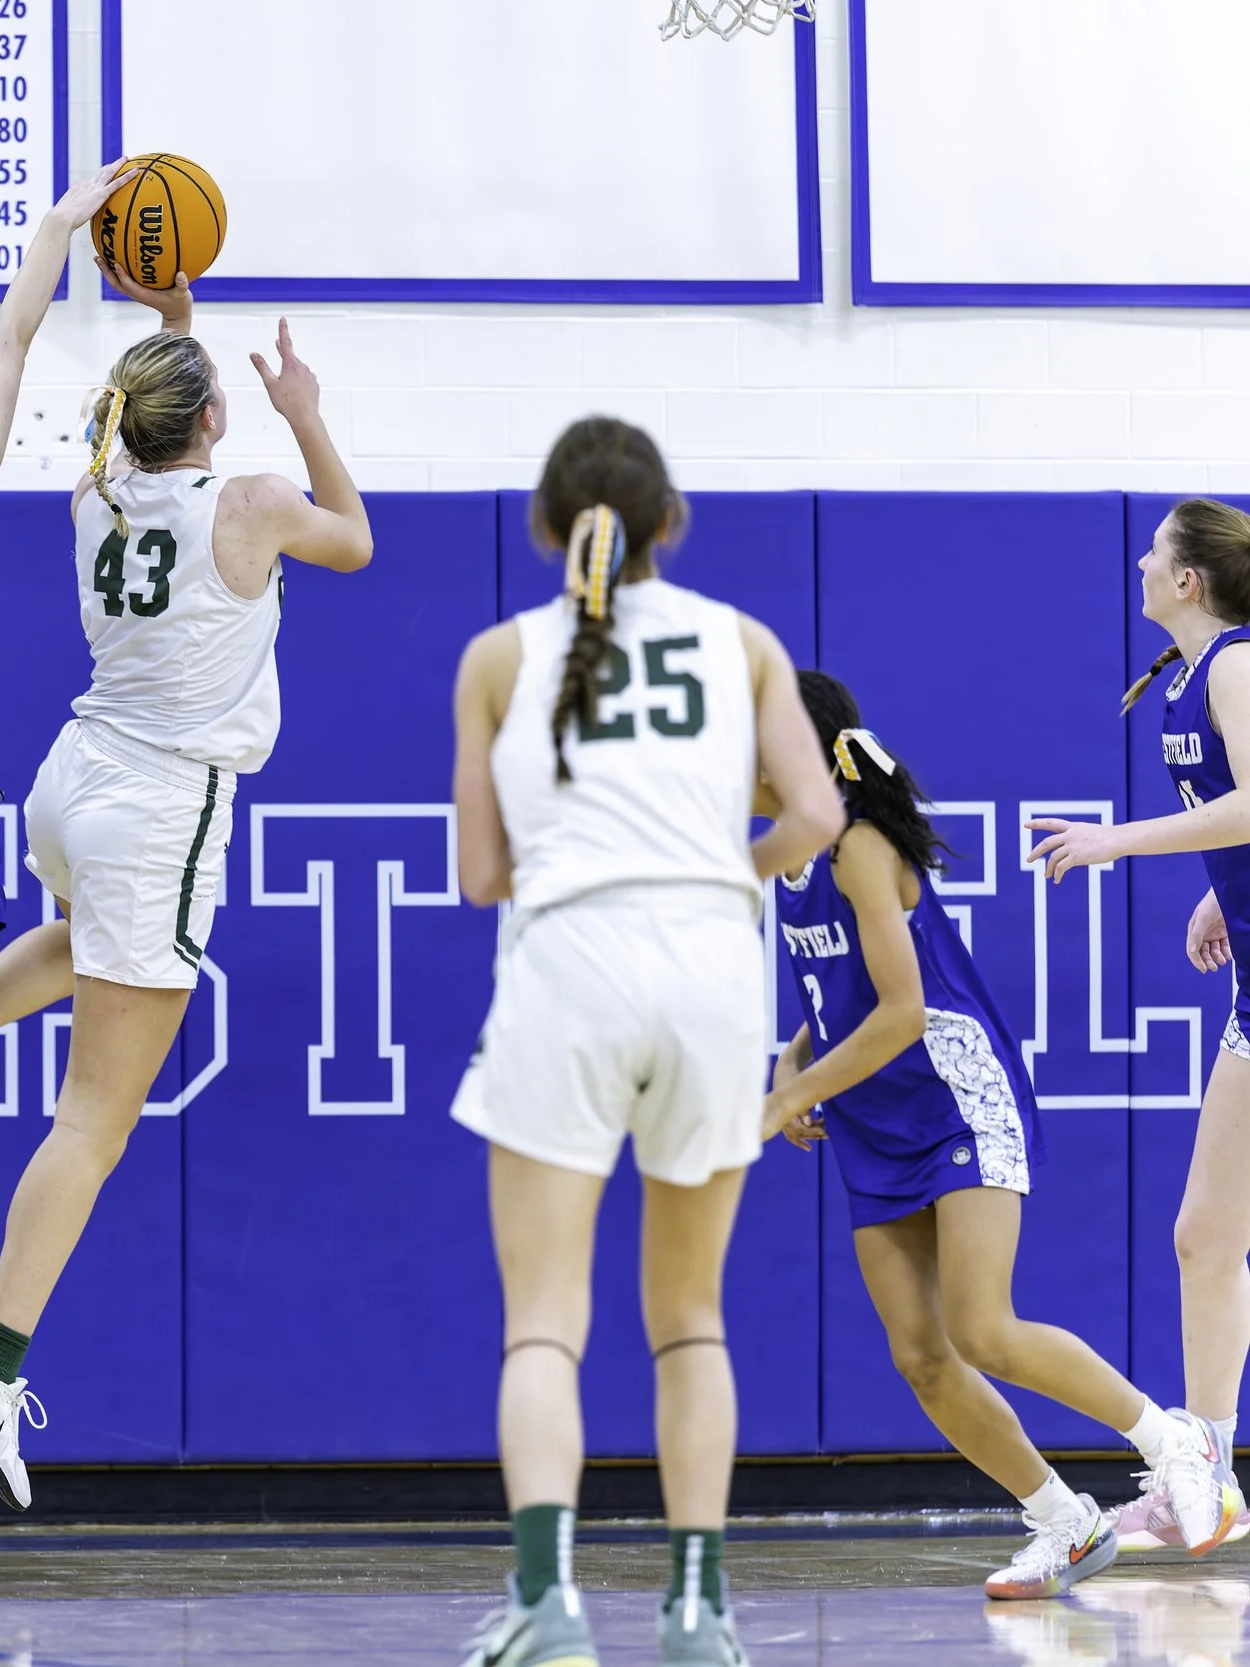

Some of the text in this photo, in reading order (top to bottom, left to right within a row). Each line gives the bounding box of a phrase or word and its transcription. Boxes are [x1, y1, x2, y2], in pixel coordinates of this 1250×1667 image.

[139, 204, 163, 284] Wilson
[94, 528, 177, 618] 43
[577, 635, 705, 742] 25
